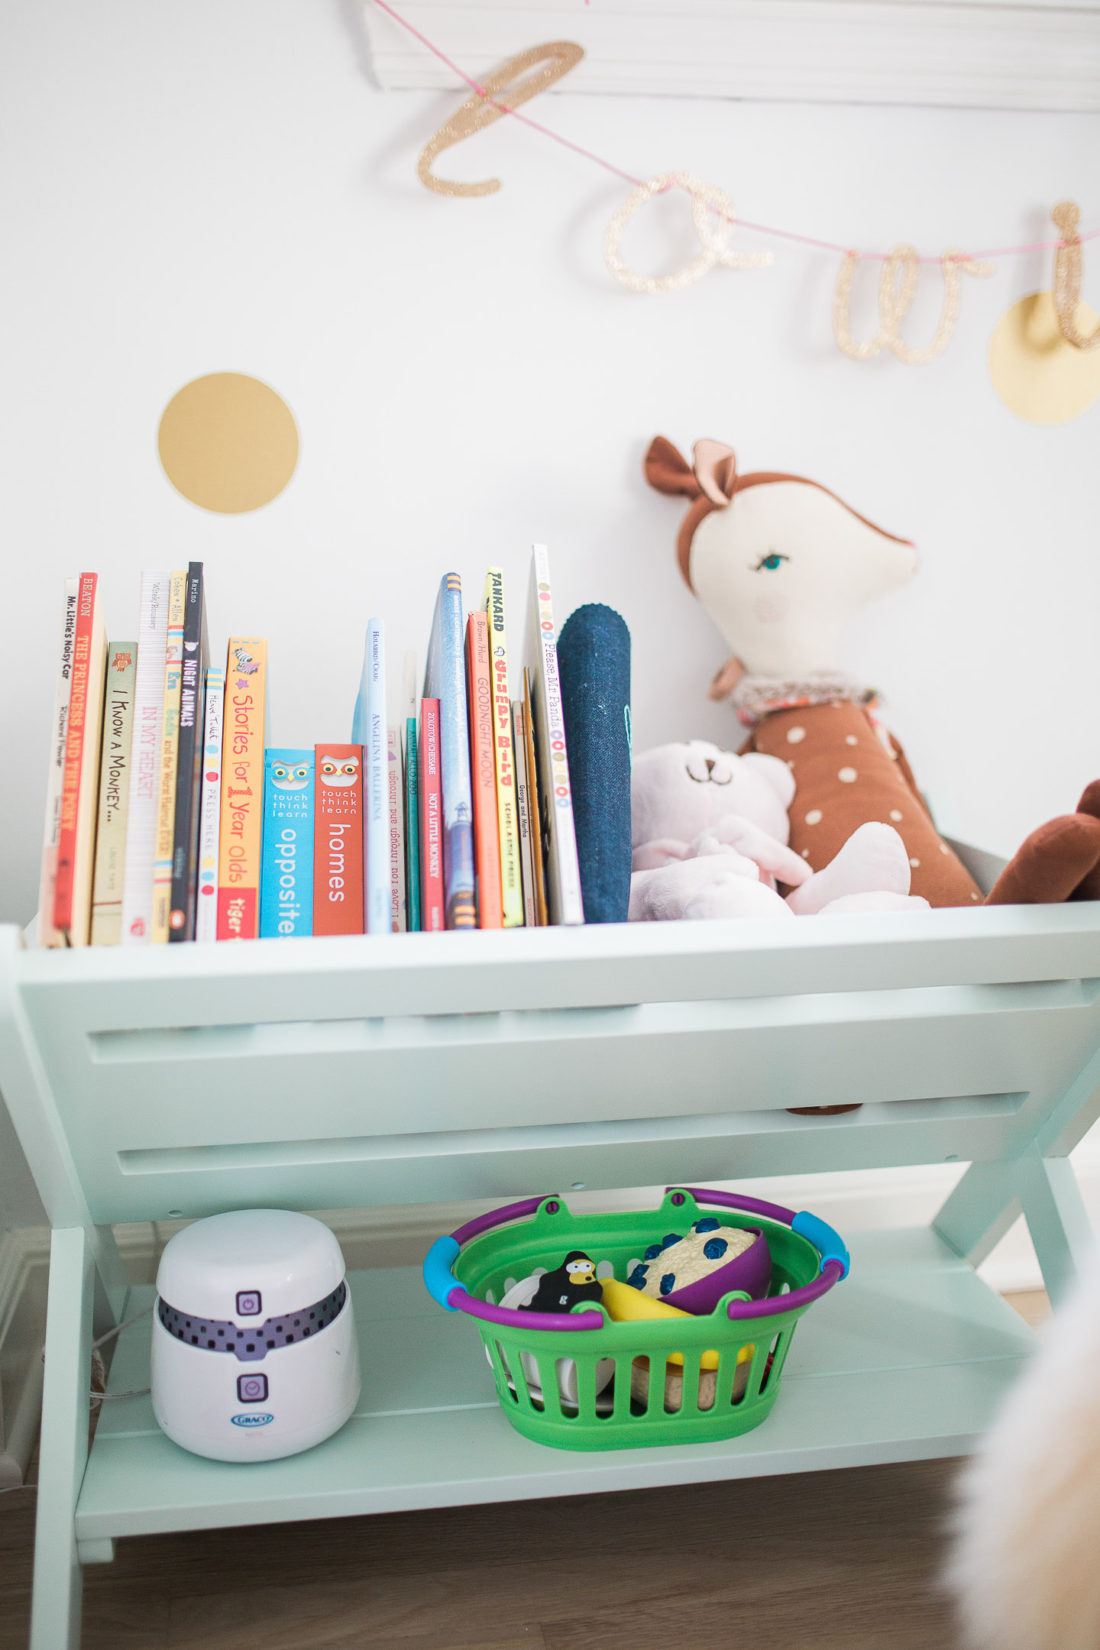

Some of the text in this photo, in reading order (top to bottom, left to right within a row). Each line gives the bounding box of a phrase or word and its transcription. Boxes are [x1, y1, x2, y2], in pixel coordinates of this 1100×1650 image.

[61, 595, 76, 679] Mr. Little's Noisy Car
[183, 660, 197, 687] NIGHT
[492, 573, 512, 787] TANKARD Grumpy Bird
[60, 578, 93, 831] BEATON THE PRINCESS AND THE PONY
[143, 706, 158, 722] IN
[181, 688, 196, 727] ANIMALS
[478, 678, 491, 745] GOODNIGHT
[550, 697, 561, 728] Panda
[140, 725, 157, 747] MY
[232, 695, 255, 755] Stories
[372, 713, 381, 762] ANGELINA
[111, 742, 122, 750] A
[136, 751, 154, 799] HEART
[232, 761, 250, 783] for
[480, 751, 493, 788] MOON
[228, 786, 253, 798] 1
[322, 790, 356, 798] touch
[322, 798, 357, 806] think
[372, 765, 381, 821] BALLERINA
[388, 770, 399, 805] Through
[205, 788, 217, 849] PRESS HERE
[272, 810, 308, 818] learn
[273, 802, 308, 810] think
[322, 806, 356, 814] learn
[390, 829, 400, 862] Through
[429, 793, 439, 878] NOT A LITTLE MONKEY
[328, 824, 351, 902] homes
[391, 867, 399, 884] You
[274, 828, 301, 939] opposite
[391, 889, 399, 912] Love
[227, 897, 246, 934] tiger
[238, 1416, 271, 1424] GRACO
